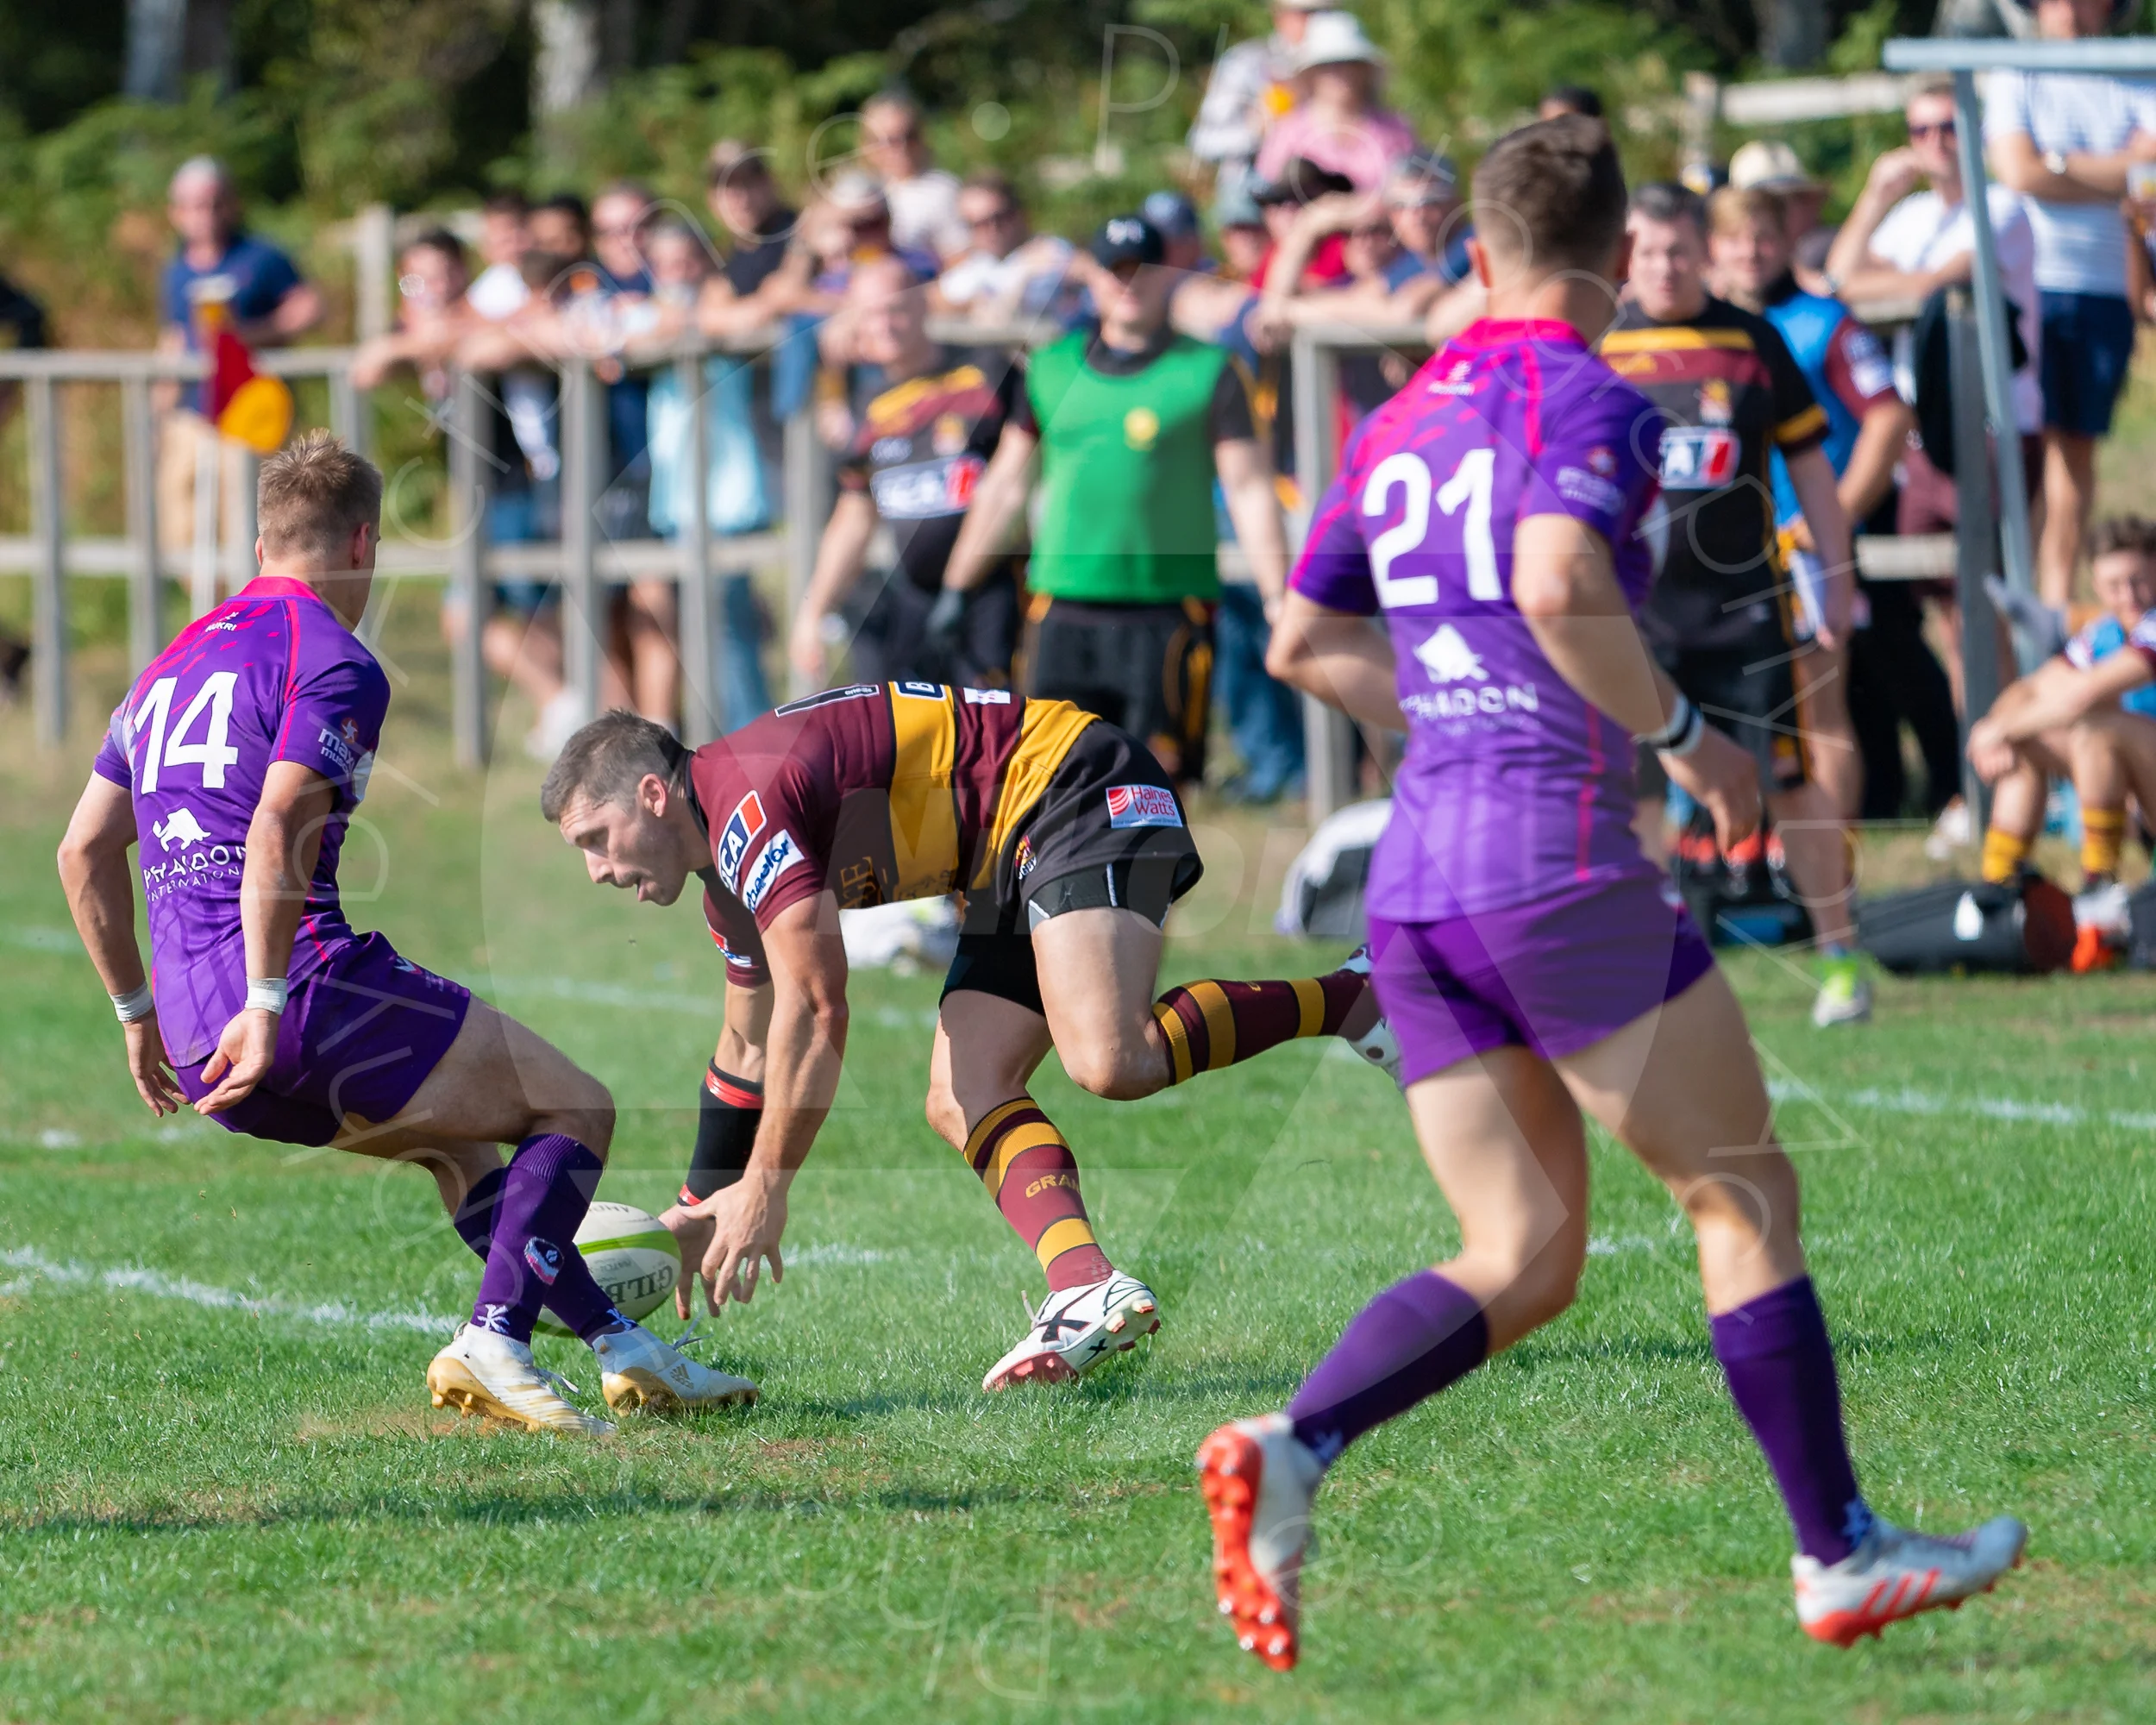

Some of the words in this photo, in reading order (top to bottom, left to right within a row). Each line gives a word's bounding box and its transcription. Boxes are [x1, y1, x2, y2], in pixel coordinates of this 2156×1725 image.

[1363, 448, 1502, 608] 21
[134, 671, 239, 794] 14
[1131, 785, 1174, 804] Haines
[1134, 800, 1175, 817] Watts
[600, 1264, 674, 1304] GILB
